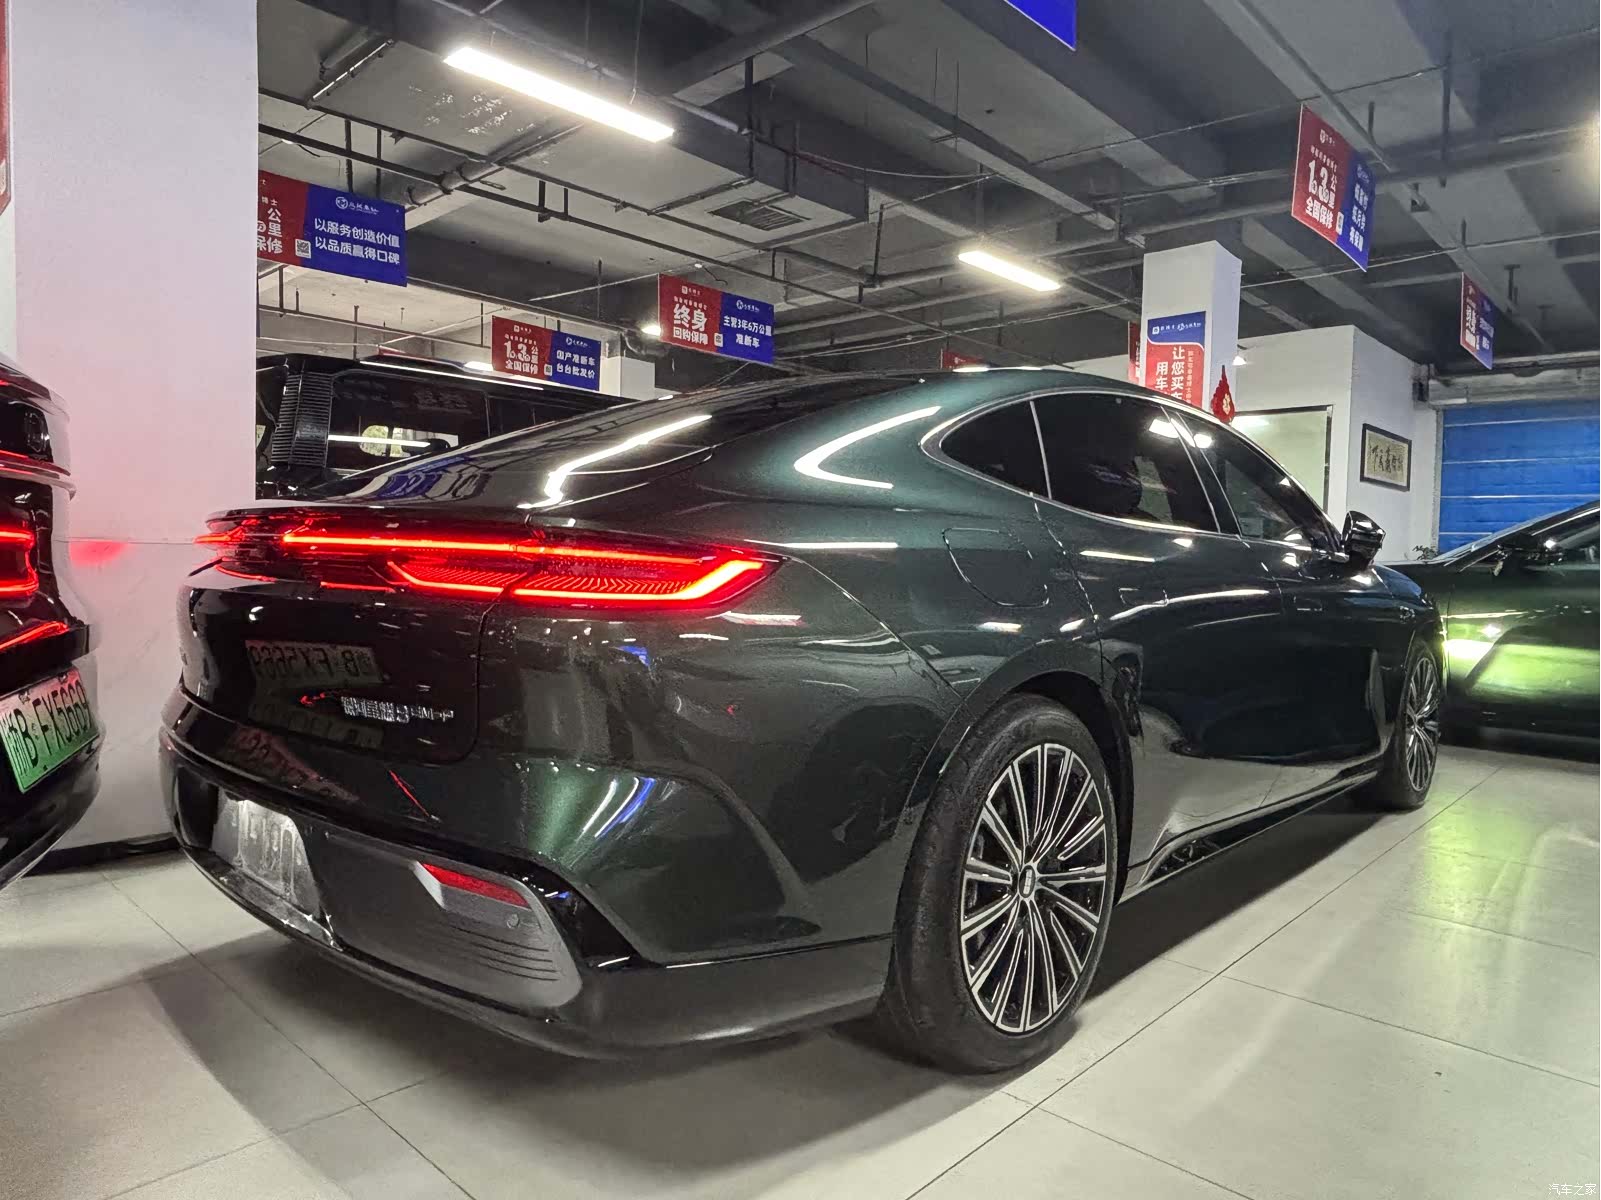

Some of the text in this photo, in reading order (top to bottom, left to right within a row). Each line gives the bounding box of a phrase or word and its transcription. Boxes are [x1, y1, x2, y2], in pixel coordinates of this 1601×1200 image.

[314, 217, 400, 248] 以服务创造价值
[315, 236, 400, 265] 以品质赢得口碑
[673, 303, 707, 332] 终身
[556, 349, 596, 366] 国产准新车
[1155, 361, 1169, 391] 用车
